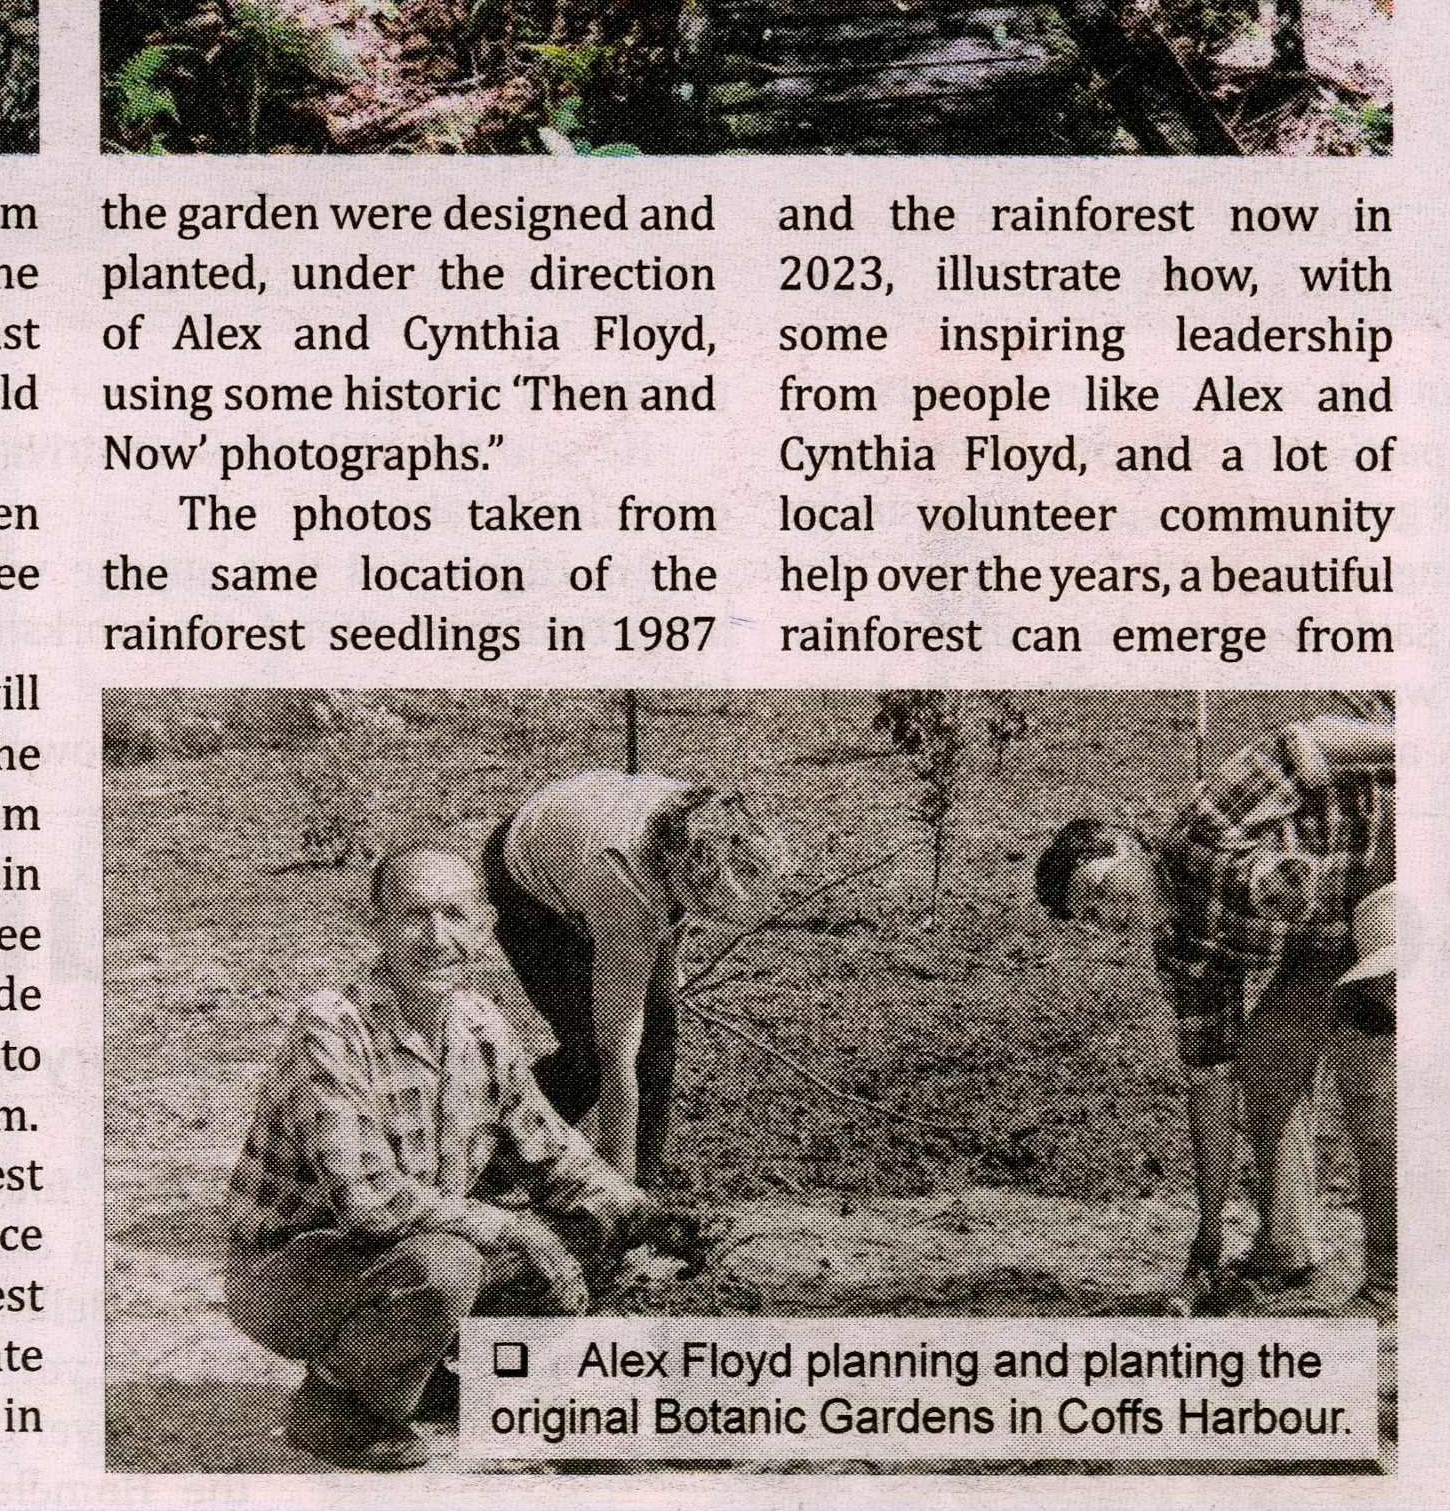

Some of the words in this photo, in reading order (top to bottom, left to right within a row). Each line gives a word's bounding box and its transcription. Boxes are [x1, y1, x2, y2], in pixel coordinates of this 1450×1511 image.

[103, 253, 266, 300] planted,
[292, 253, 415, 290] under
[439, 253, 505, 291] the
[530, 253, 715, 291] direction
[780, 255, 894, 296] 2023,
[937, 254, 1121, 292] illustrate
[1163, 255, 1258, 297] how,
[1300, 255, 1392, 293] with
[103, 375, 213, 421] using
[224, 385, 333, 411] some
[345, 374, 501, 411] historic
[513, 374, 628, 411] ‘Then
[640, 374, 716, 411] and
[780, 494, 874, 532] local
[917, 494, 1117, 532] volunteer
[1160, 497, 1395, 543] community
[104, 614, 305, 651] rainforest
[330, 614, 520, 662] seedlings
[548, 616, 585, 652] in
[614, 616, 716, 652] 1987
[577, 1341, 669, 1378] Alex
[682, 1341, 792, 1388] Floyd
[807, 1341, 979, 1387] planning
[993, 1341, 1069, 1378] and
[1083, 1341, 1245, 1388] planting
[1257, 1342, 1322, 1379] the
[491, 1397, 639, 1444] original
[654, 1397, 807, 1435] Botanic
[819, 1396, 995, 1435] Gardens
[1010, 1397, 1043, 1435] in
[1057, 1396, 1164, 1435] Coffs
[1179, 1397, 1351, 1436] Harbour.
